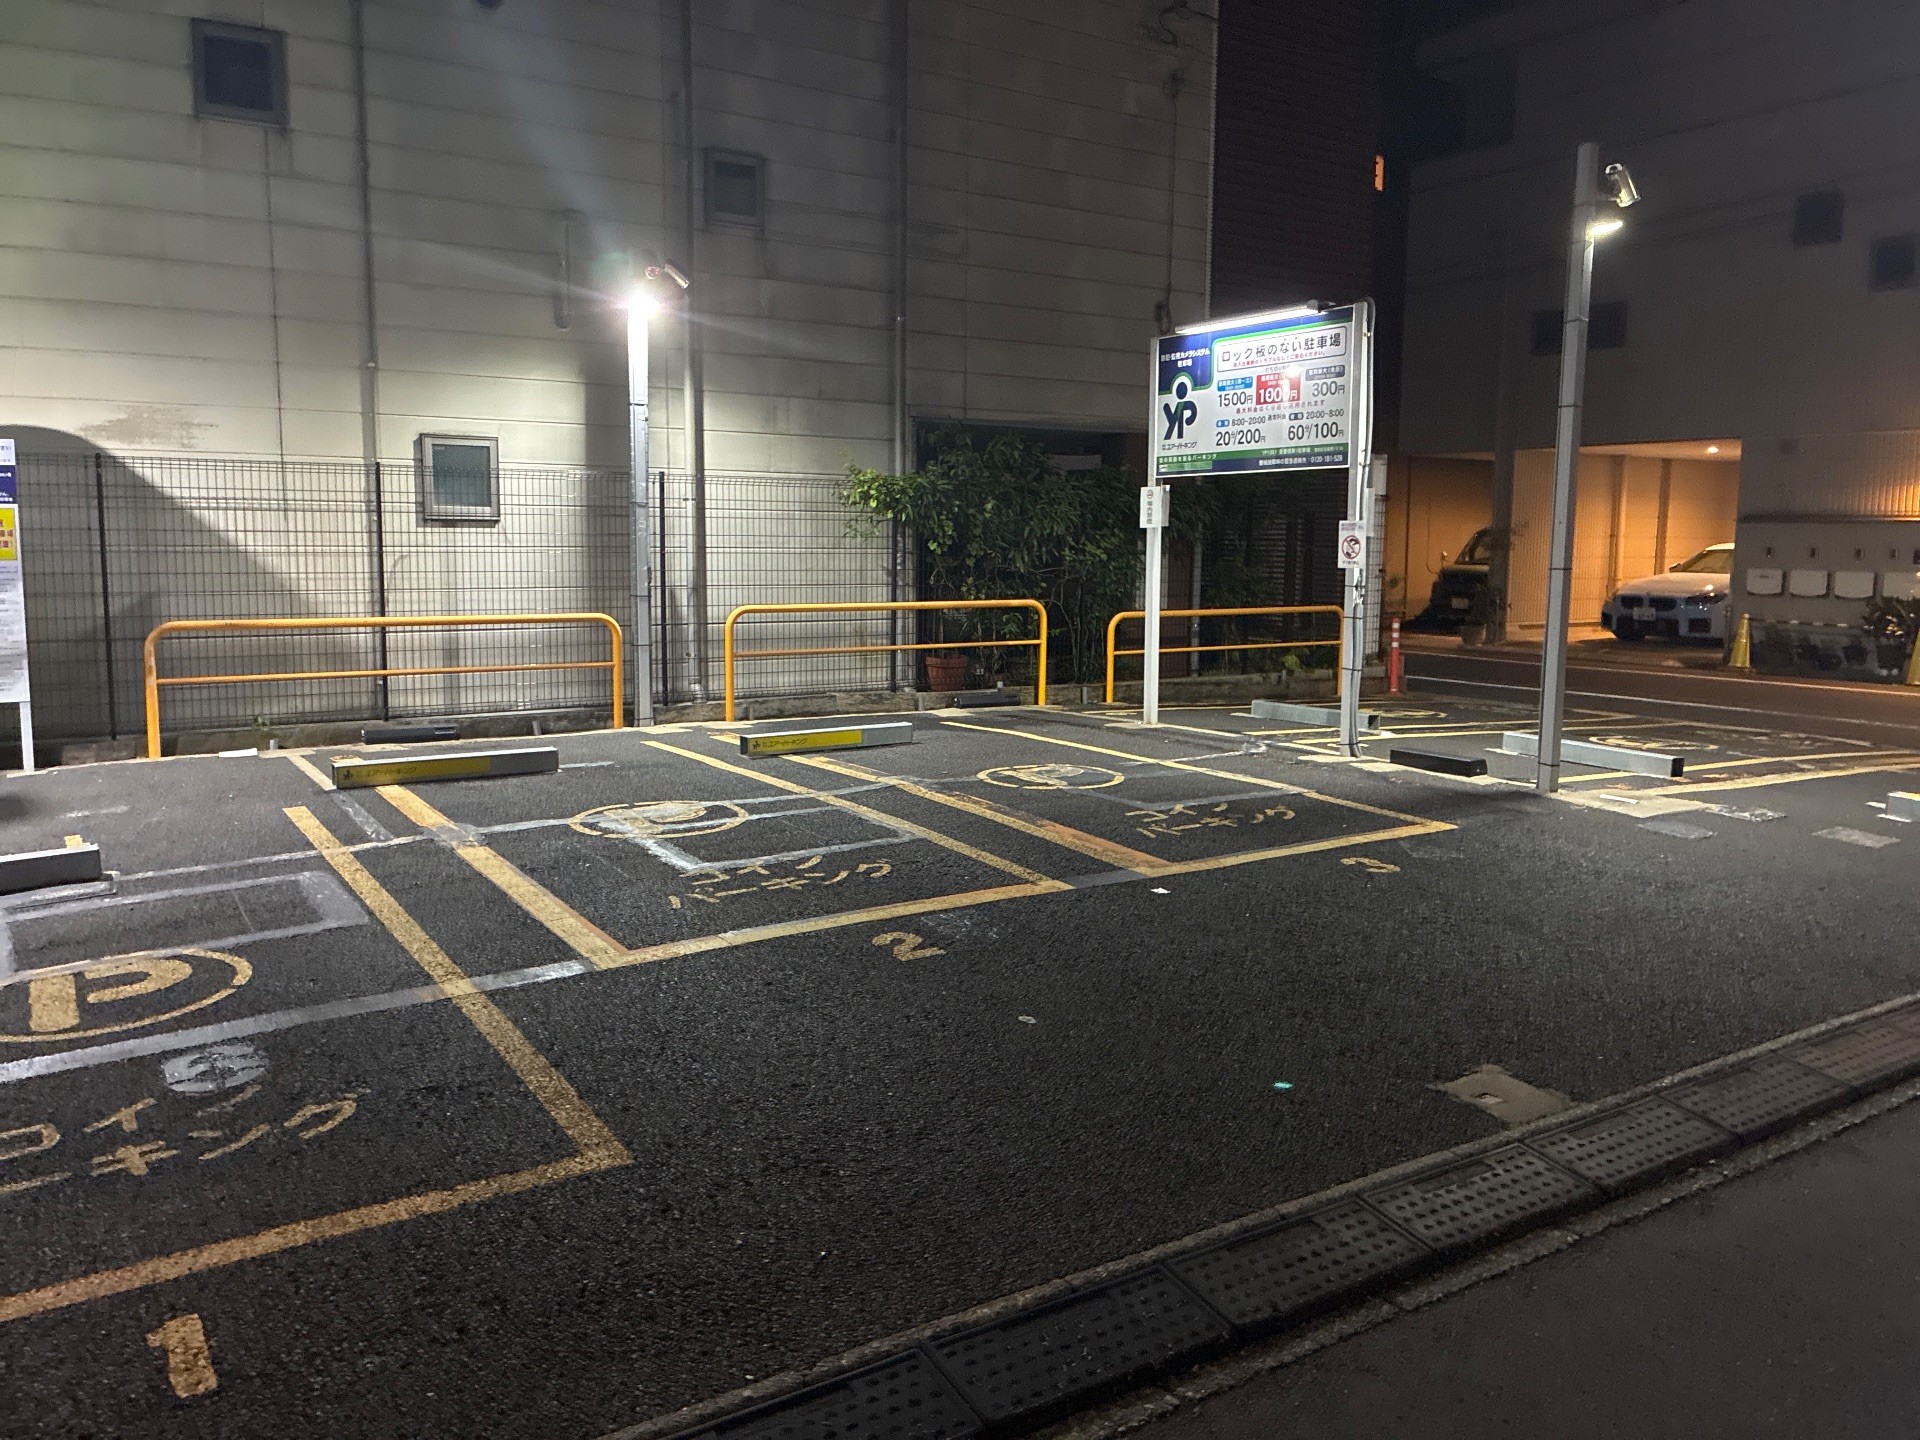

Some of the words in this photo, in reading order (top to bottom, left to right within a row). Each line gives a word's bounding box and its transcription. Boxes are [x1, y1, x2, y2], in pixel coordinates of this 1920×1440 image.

[1222, 333, 1341, 362] ロック板のない駐車場
[1218, 391, 1253, 407] 1500円
[1312, 381, 1345, 397] 300円
[667, 858, 892, 910] パーキング
[872, 931, 946, 962] 2
[28, 957, 194, 1033] P
[145, 1313, 218, 1398] 1
